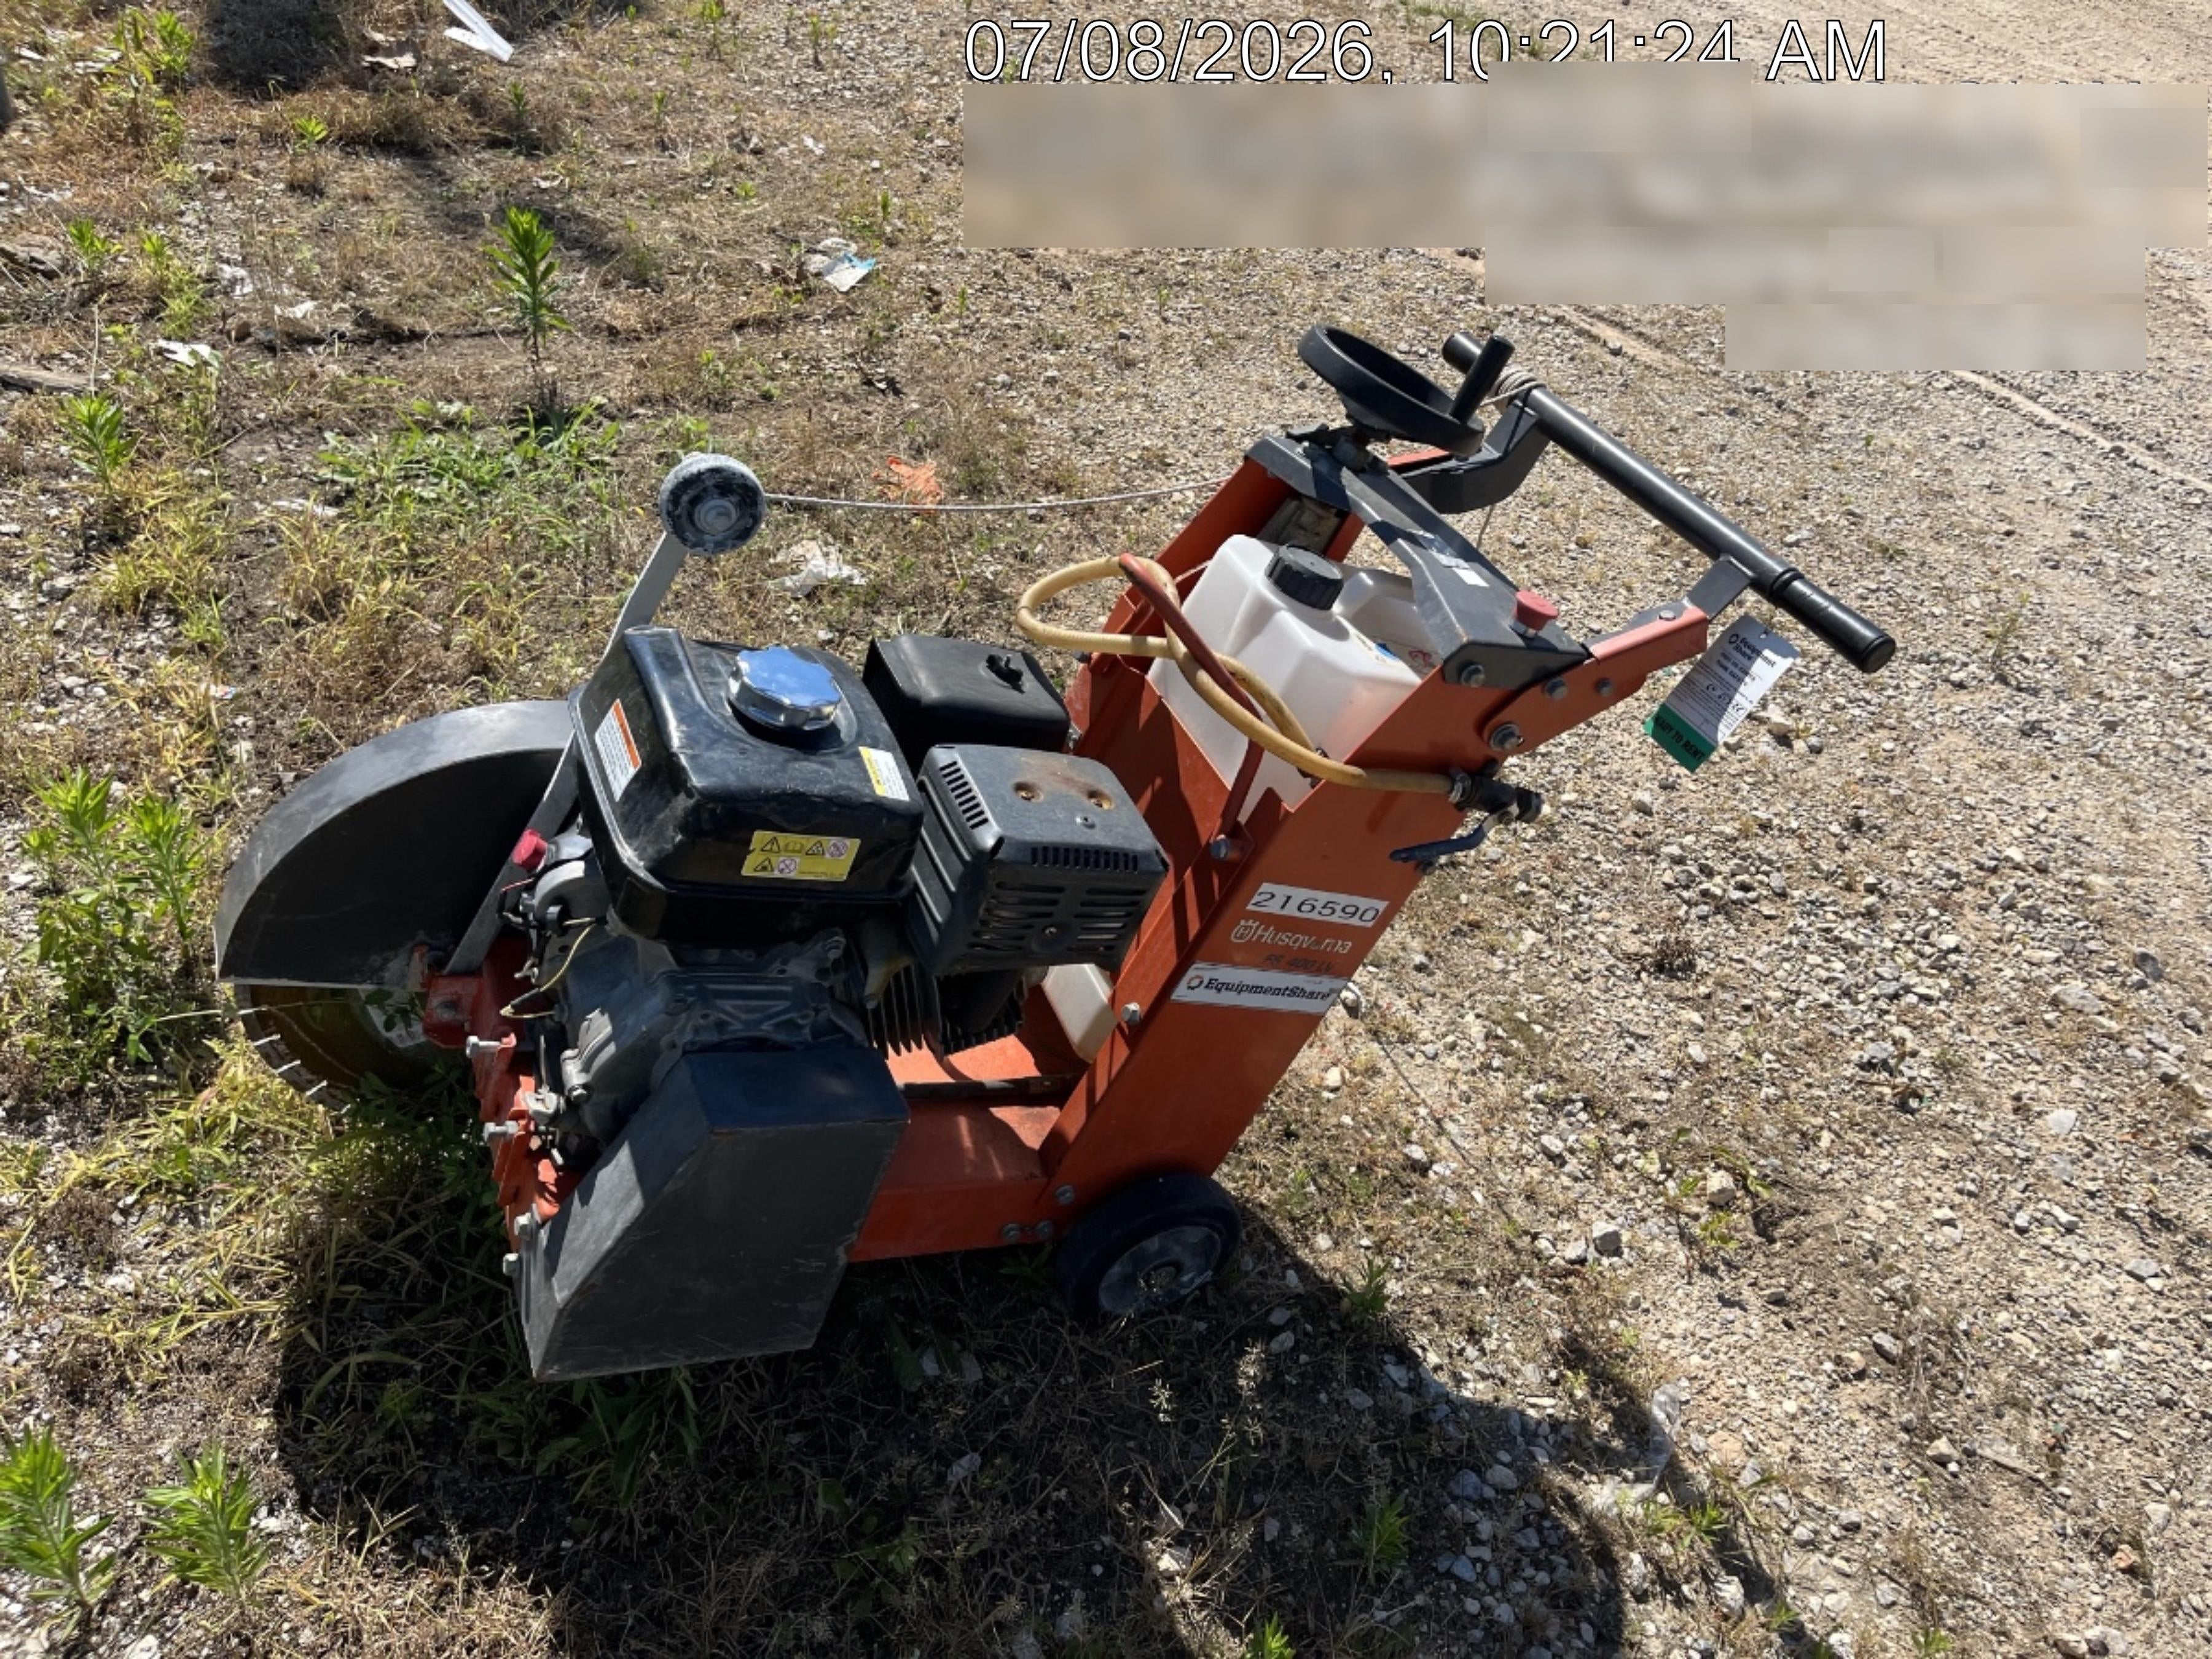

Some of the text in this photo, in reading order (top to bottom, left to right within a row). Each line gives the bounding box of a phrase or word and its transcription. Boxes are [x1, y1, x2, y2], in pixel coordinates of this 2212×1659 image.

[1682, 739, 1706, 761] RENT
[1251, 891, 1380, 923] 216590
[1203, 978, 1330, 1000] EquipmentShare
